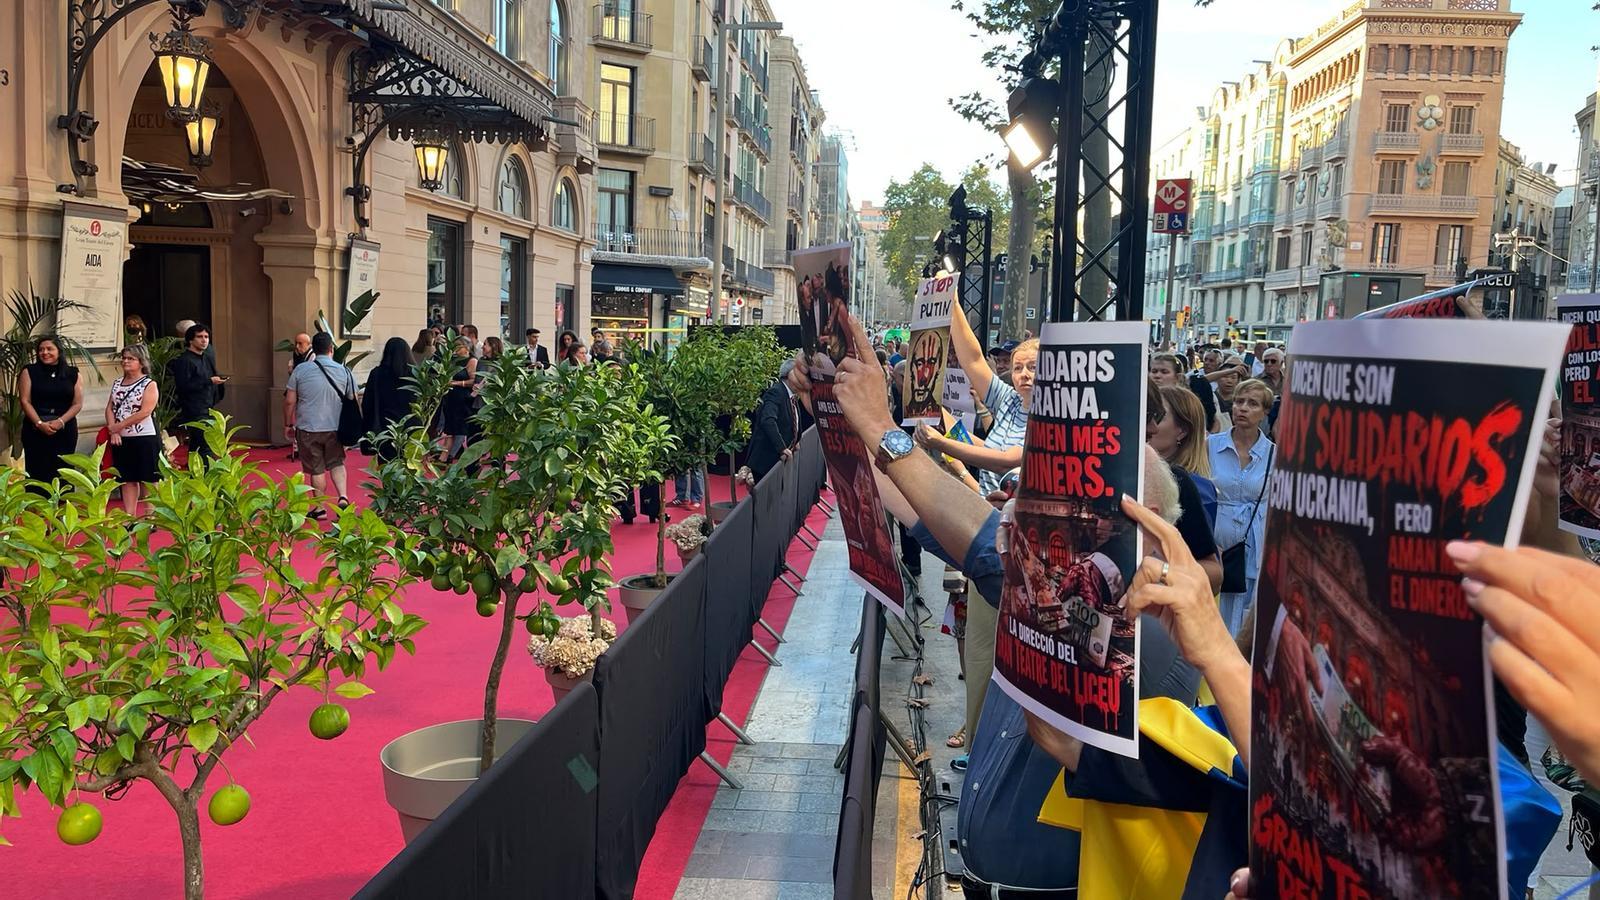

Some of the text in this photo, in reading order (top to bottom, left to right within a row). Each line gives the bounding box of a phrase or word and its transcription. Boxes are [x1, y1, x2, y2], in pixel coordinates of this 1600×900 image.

[1164, 187, 1176, 198] M
[85, 254, 102, 267] AIDA
[1475, 274, 1512, 287] LICEU
[920, 300, 951, 319] PUTIN
[1562, 311, 1584, 323] DICEN
[1565, 366, 1590, 382] PERO
[1568, 351, 1584, 365] CON
[1292, 361, 1396, 406] DICEN QUE SON
[1573, 382, 1594, 403] EL
[1072, 421, 1121, 455] MÉS
[1315, 400, 1522, 507] SOLIDARIOS
[1026, 451, 1115, 497] DINERS.
[1296, 472, 1375, 535] UCRANIA,
[1395, 502, 1432, 533] PERO
[1388, 535, 1436, 573] AMAN
[1391, 575, 1416, 609] EL
[1009, 616, 1078, 665] LA DIRECCIÓ DEL
[1015, 638, 1048, 688] TEATRE
[1050, 658, 1070, 695] DEL
[1074, 666, 1121, 712] LICEU
[1466, 794, 1490, 823] Z
[1253, 793, 1324, 892] GRAN
